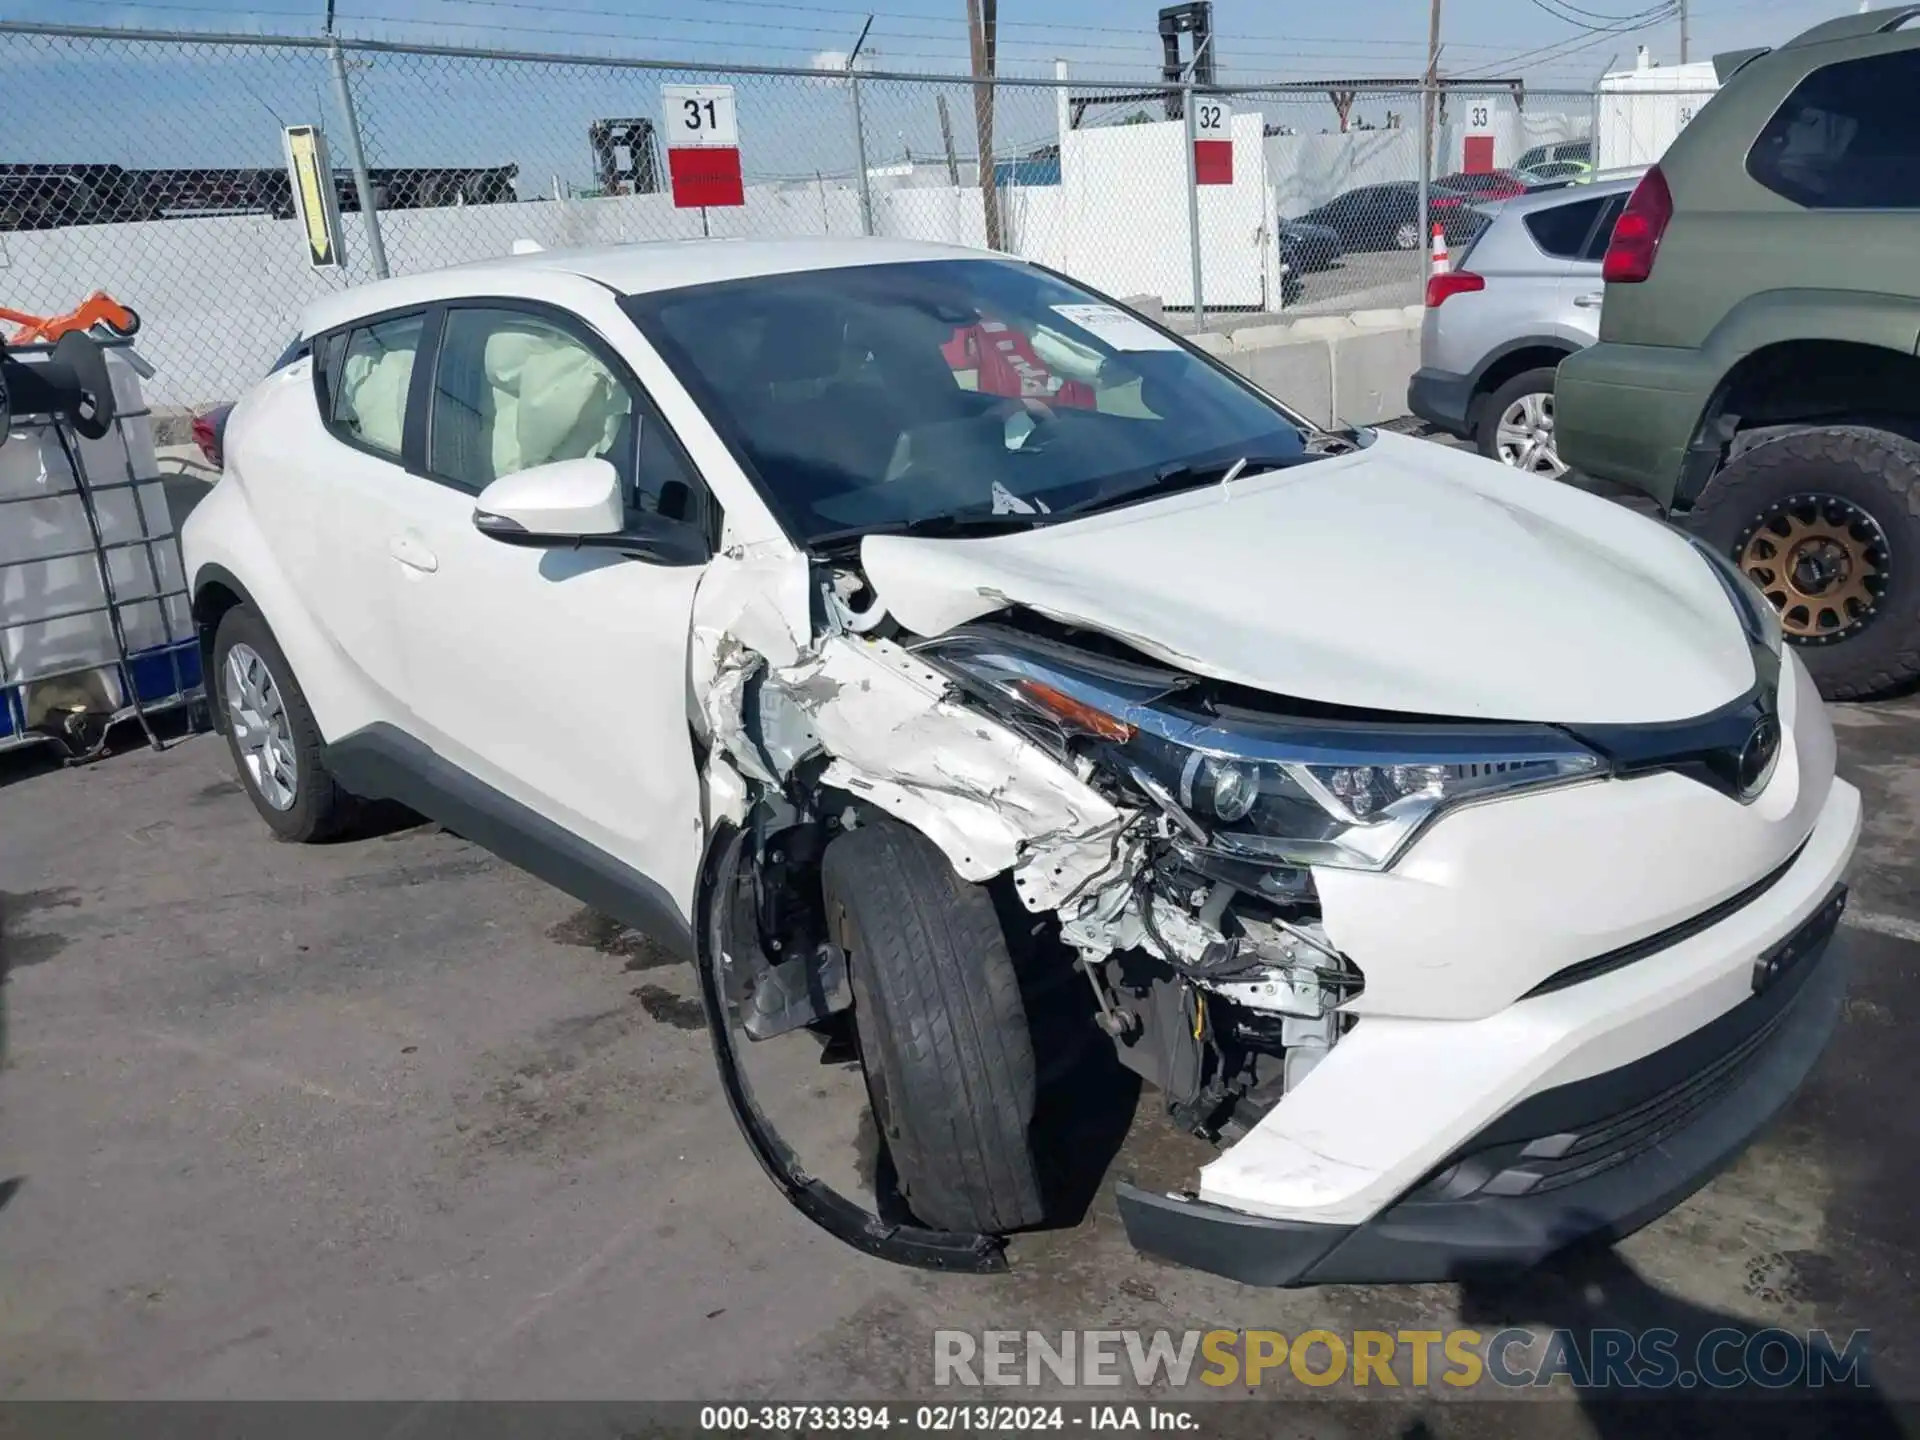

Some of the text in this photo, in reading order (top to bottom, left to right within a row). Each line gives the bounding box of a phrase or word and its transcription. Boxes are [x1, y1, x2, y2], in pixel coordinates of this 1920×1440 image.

[684, 99, 716, 130] 31
[1200, 105, 1221, 129] 32
[1472, 107, 1488, 127] 33
